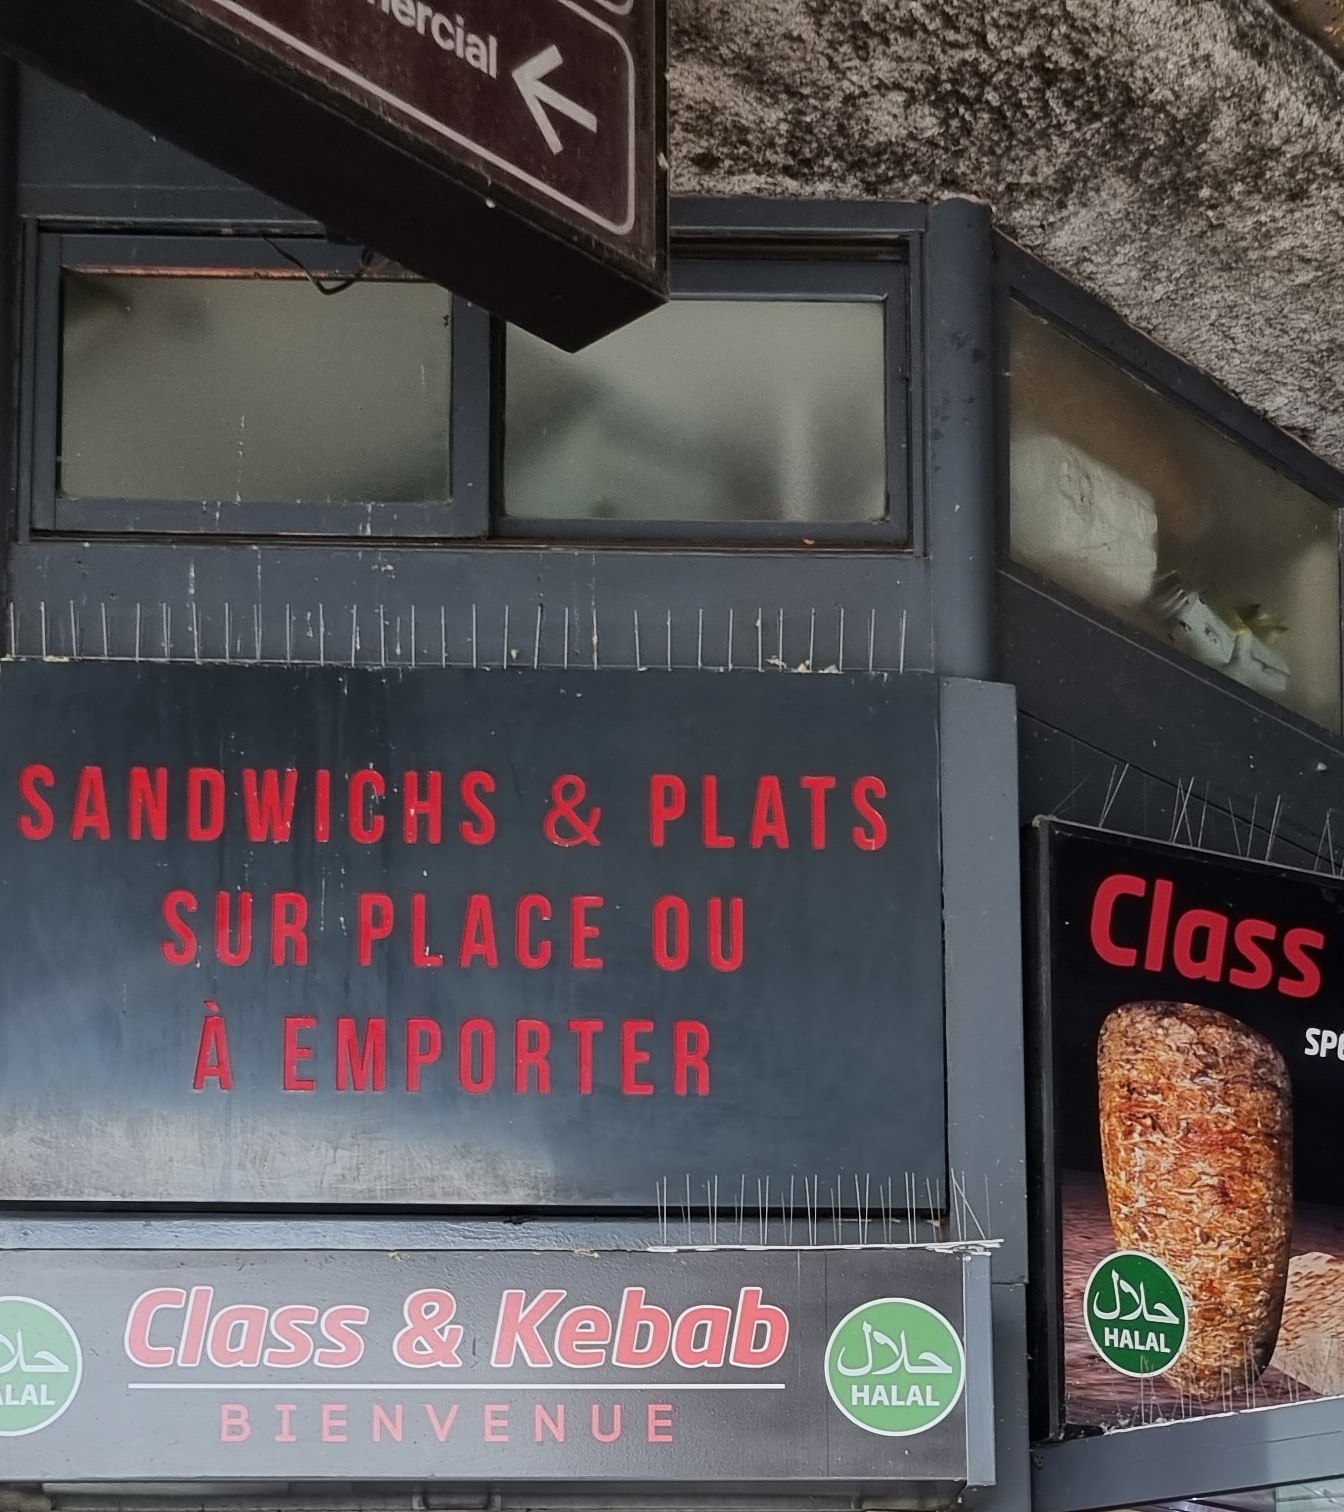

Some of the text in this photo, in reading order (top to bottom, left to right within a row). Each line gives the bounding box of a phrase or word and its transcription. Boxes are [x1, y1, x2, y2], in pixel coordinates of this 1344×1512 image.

[367, 0, 497, 78] ercial
[18, 764, 888, 851] SANDWICHS & PLATS
[161, 891, 746, 972] SUR PLACE OU
[1090, 874, 1324, 998] Class
[192, 1001, 712, 1097] À EMPORTER
[124, 1286, 790, 1371] Class & Kebab
[1103, 1325, 1172, 1354] HALAL
[220, 1403, 674, 1443] BIENVENUE
[850, 1385, 940, 1407] HALAL
